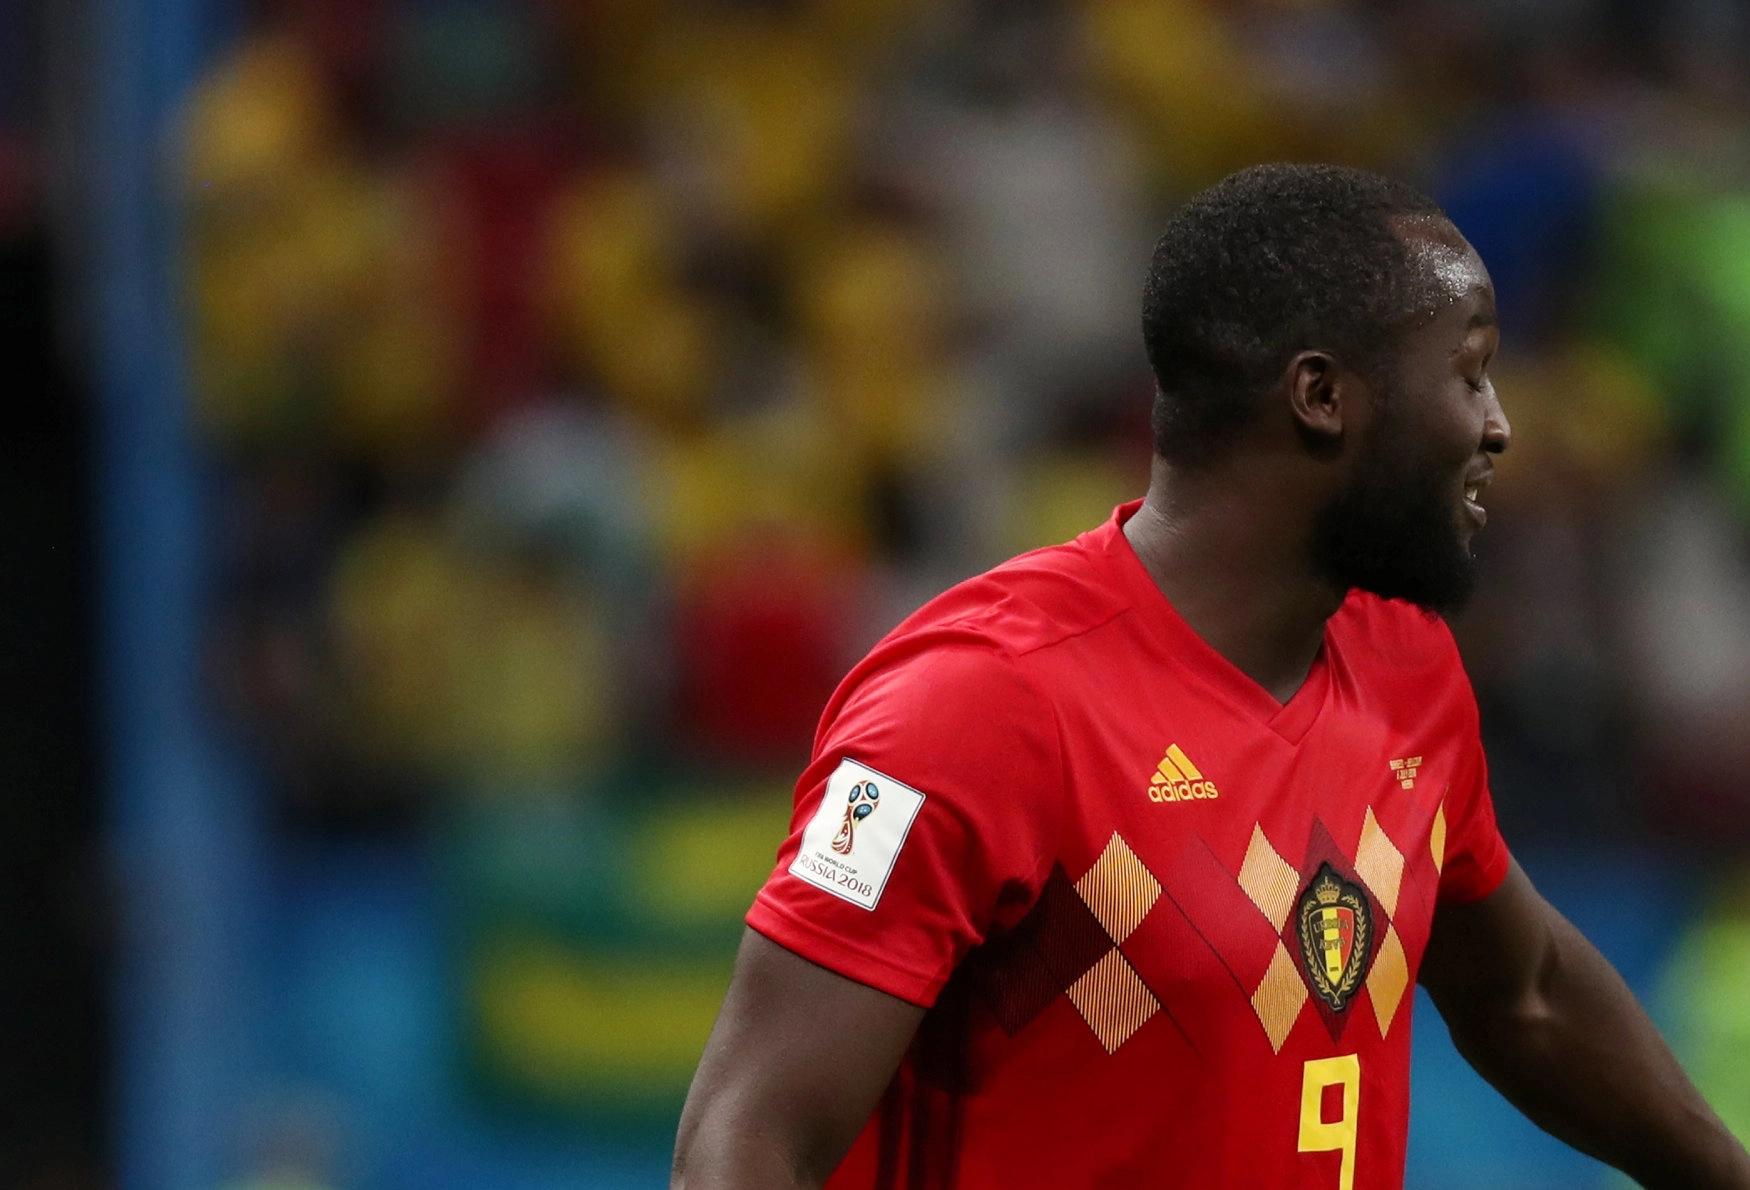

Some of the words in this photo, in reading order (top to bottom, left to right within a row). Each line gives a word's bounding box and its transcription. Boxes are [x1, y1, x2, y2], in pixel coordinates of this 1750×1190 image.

[1148, 780, 1219, 802] adidas
[800, 855, 836, 881] RUSSIA
[838, 873, 873, 897] 2018
[824, 856, 845, 870] WORLD
[845, 865, 858, 876] CUP
